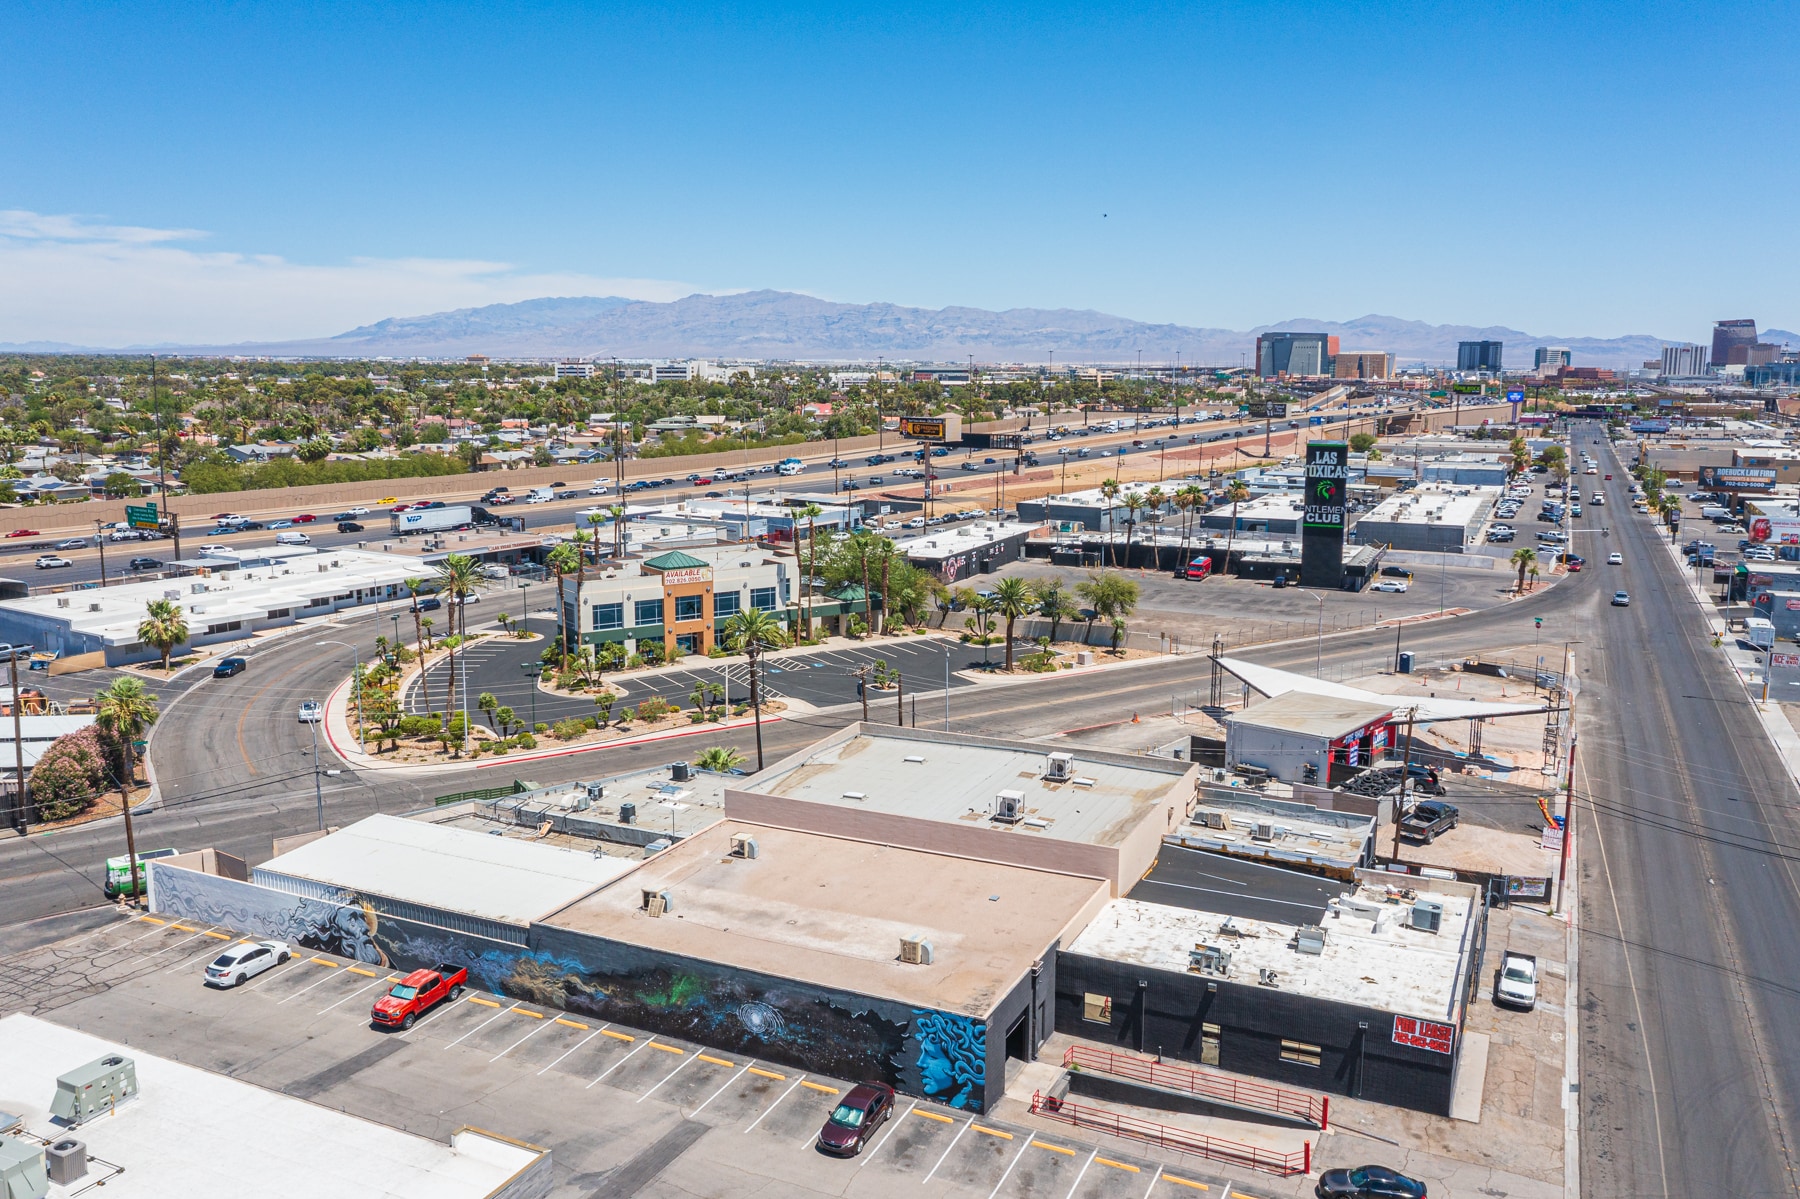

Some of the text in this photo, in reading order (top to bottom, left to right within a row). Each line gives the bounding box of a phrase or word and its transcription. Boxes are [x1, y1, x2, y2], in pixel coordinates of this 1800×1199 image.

[1315, 451, 1338, 465] LAS
[1717, 468, 1776, 478] ROEBUCK LAW FIRM
[406, 515, 422, 523] VIP
[1306, 513, 1341, 523] CLUB
[666, 569, 700, 578] AVAILABLE
[1773, 654, 1785, 664] ACE
[1395, 1016, 1453, 1043] FOR LEASE
